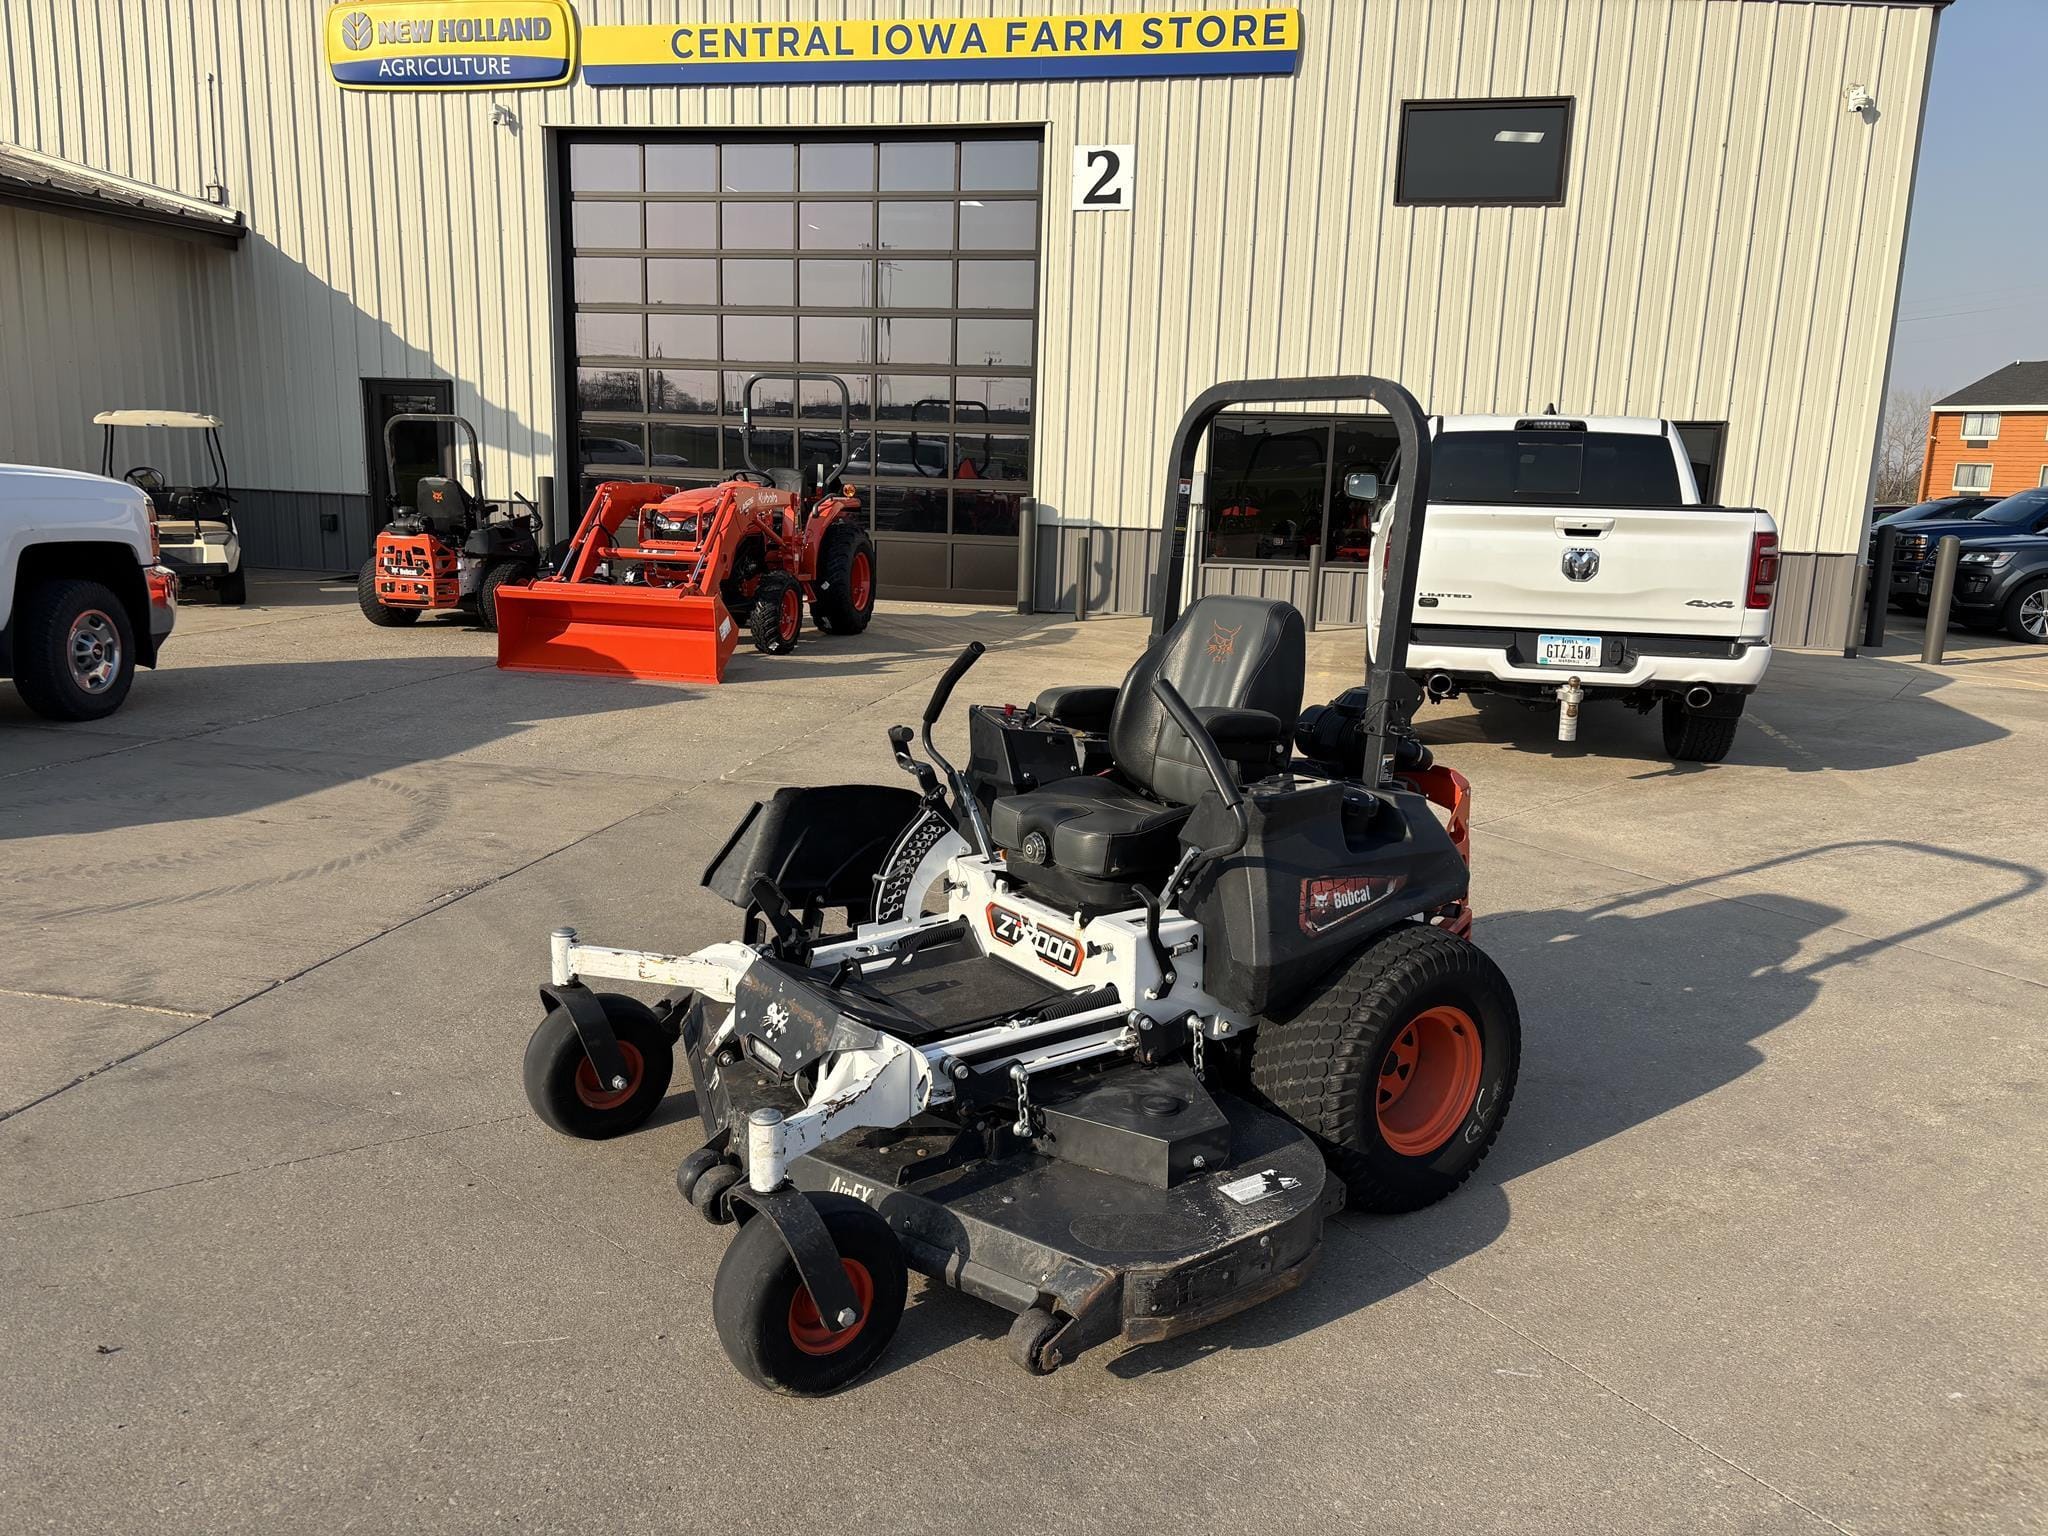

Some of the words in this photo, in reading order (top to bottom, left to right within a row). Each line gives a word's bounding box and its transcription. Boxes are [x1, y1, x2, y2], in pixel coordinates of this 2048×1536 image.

[378, 19, 433, 44] NEW
[438, 17, 552, 43] HOLLAND
[671, 26, 854, 58] CENTRAL
[872, 23, 988, 55] IOWA
[1005, 19, 1123, 53] FARM
[1140, 13, 1287, 49] STORE
[379, 57, 511, 77] AGRICULTURE
[1083, 150, 1121, 204] 2
[1546, 643, 1567, 659] GTZ
[1570, 645, 1592, 660] 150
[1334, 884, 1371, 909] Bobcat
